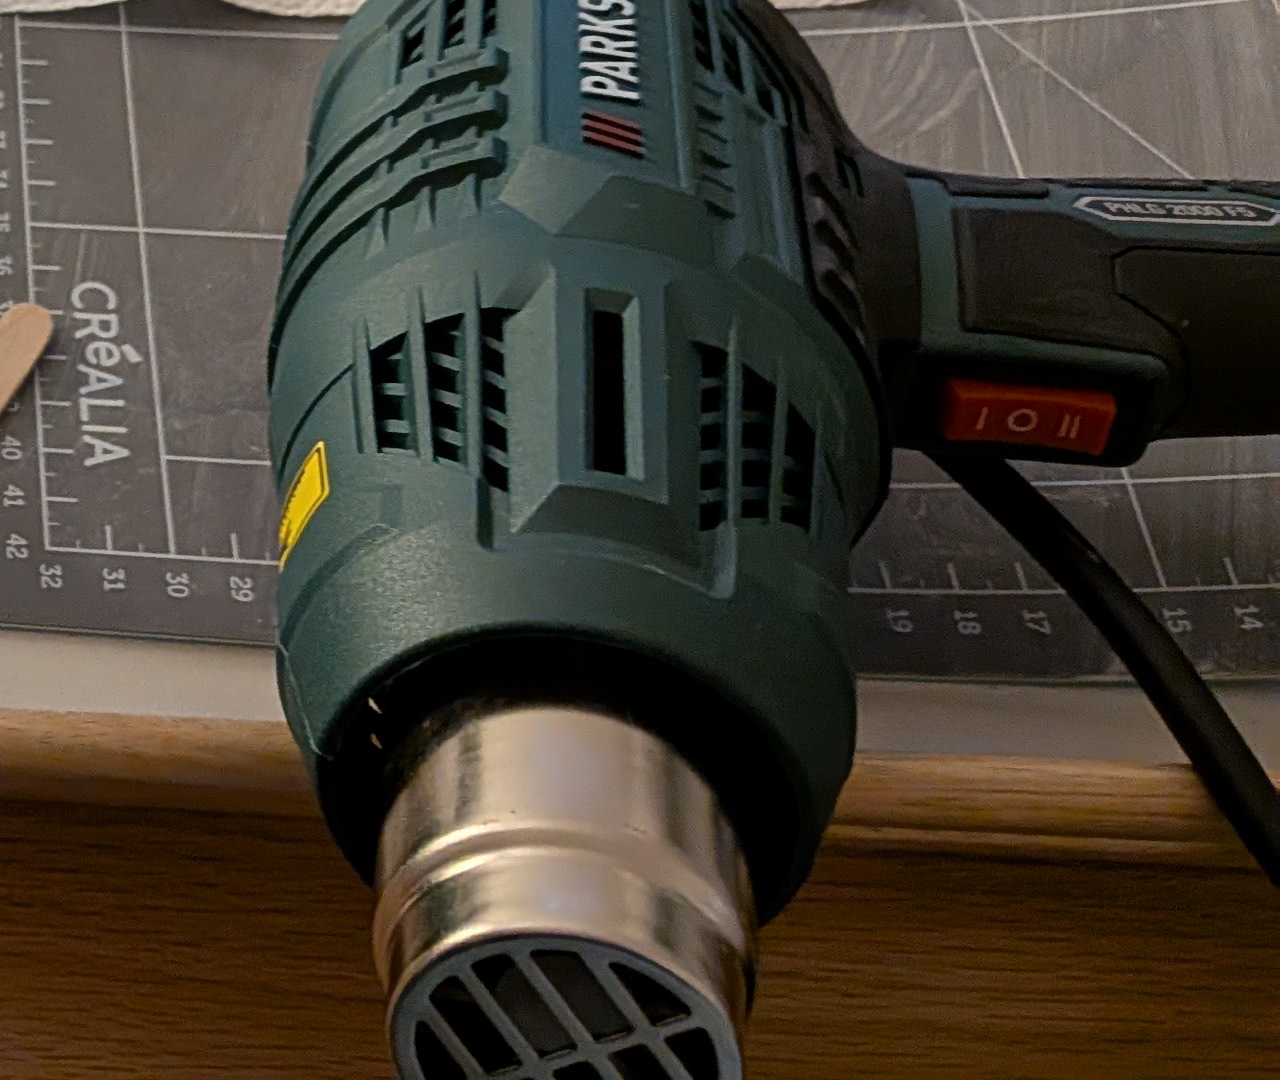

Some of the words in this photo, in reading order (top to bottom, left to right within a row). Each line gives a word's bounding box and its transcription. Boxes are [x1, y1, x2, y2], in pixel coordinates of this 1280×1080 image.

[70, 281, 144, 467] CRéALIA
[0, 435, 23, 461] 40
[2, 484, 26, 508] 41
[5, 533, 28, 560] 42
[39, 563, 63, 589] 32
[102, 567, 127, 591] 31
[165, 572, 190, 598] 30
[229, 576, 254, 602] 29
[885, 608, 914, 634] 19
[953, 608, 982, 636] 18
[1023, 609, 1052, 636] 17
[1162, 606, 1193, 634] 15
[1234, 603, 1263, 631] 14
